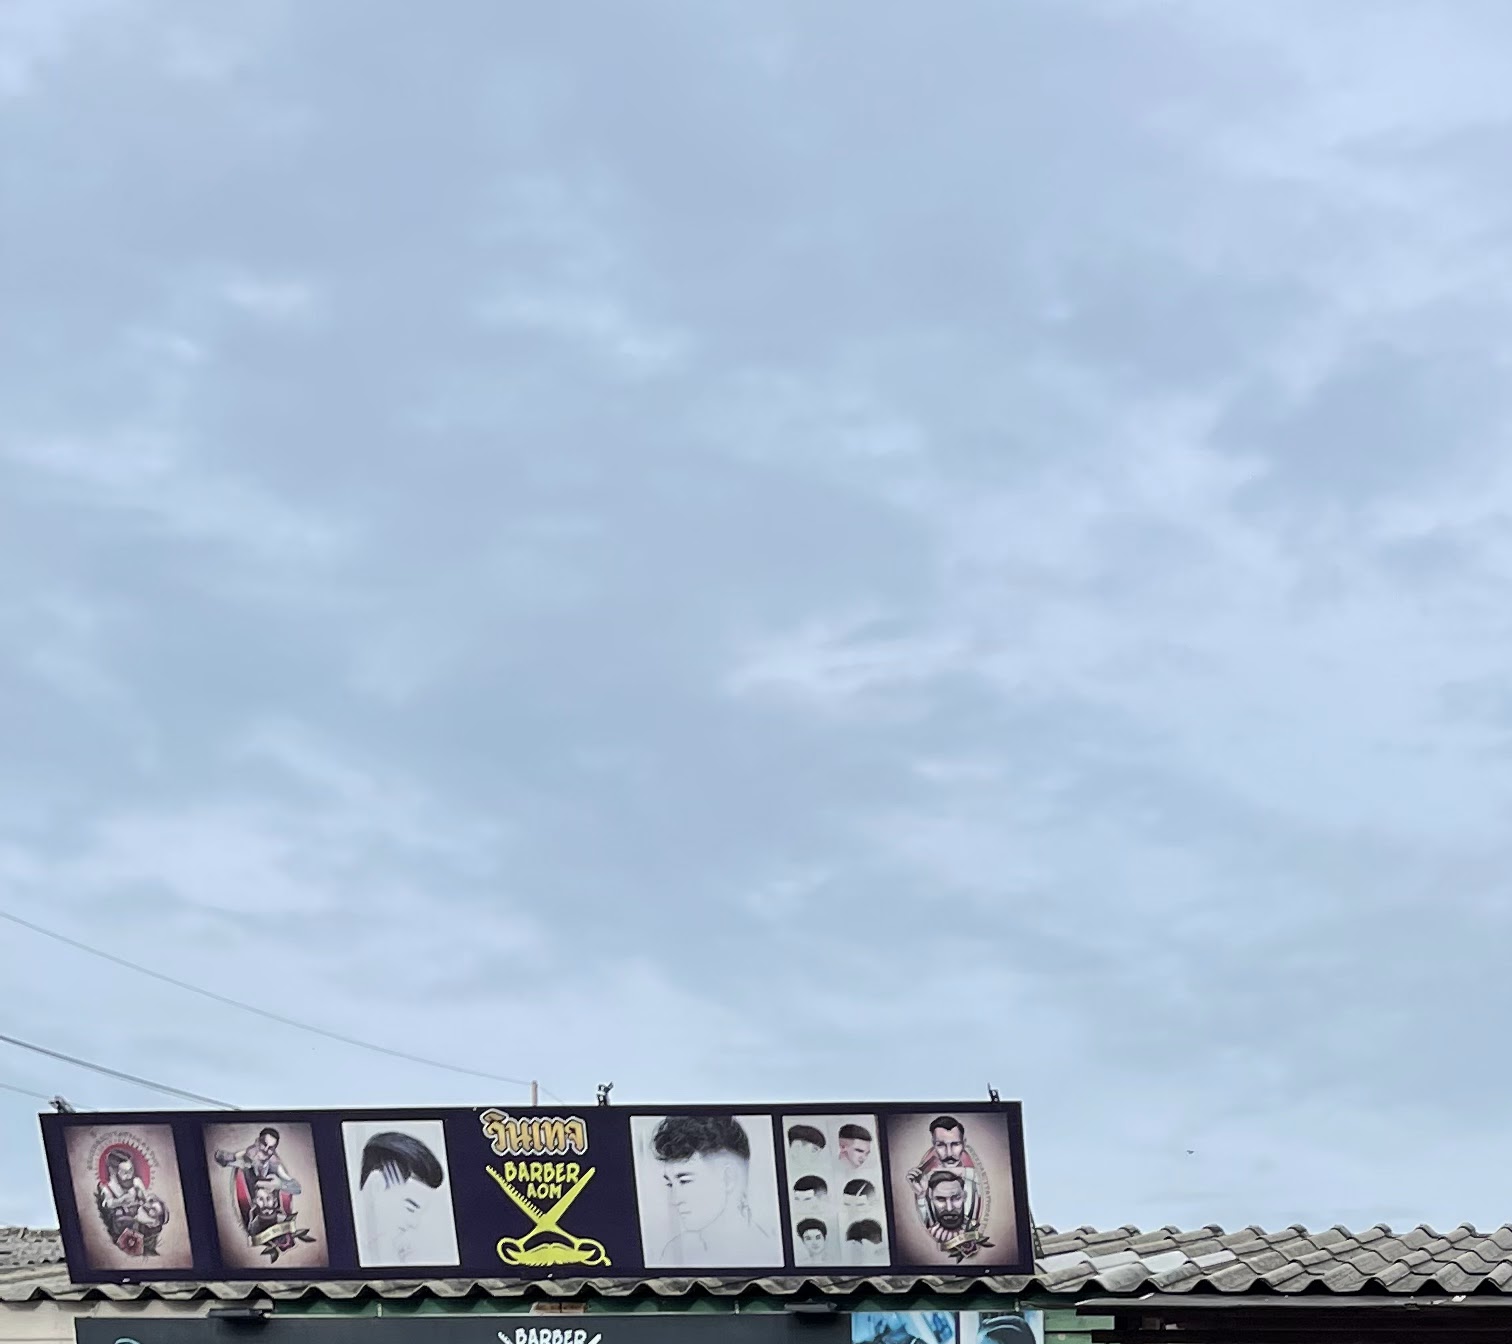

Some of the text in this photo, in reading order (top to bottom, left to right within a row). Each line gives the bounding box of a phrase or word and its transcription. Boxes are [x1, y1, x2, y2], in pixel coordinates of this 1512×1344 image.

[481, 1110, 587, 1155] วินเทจ
[504, 1161, 581, 1184] BARBER
[527, 1183, 563, 1199] AOM
